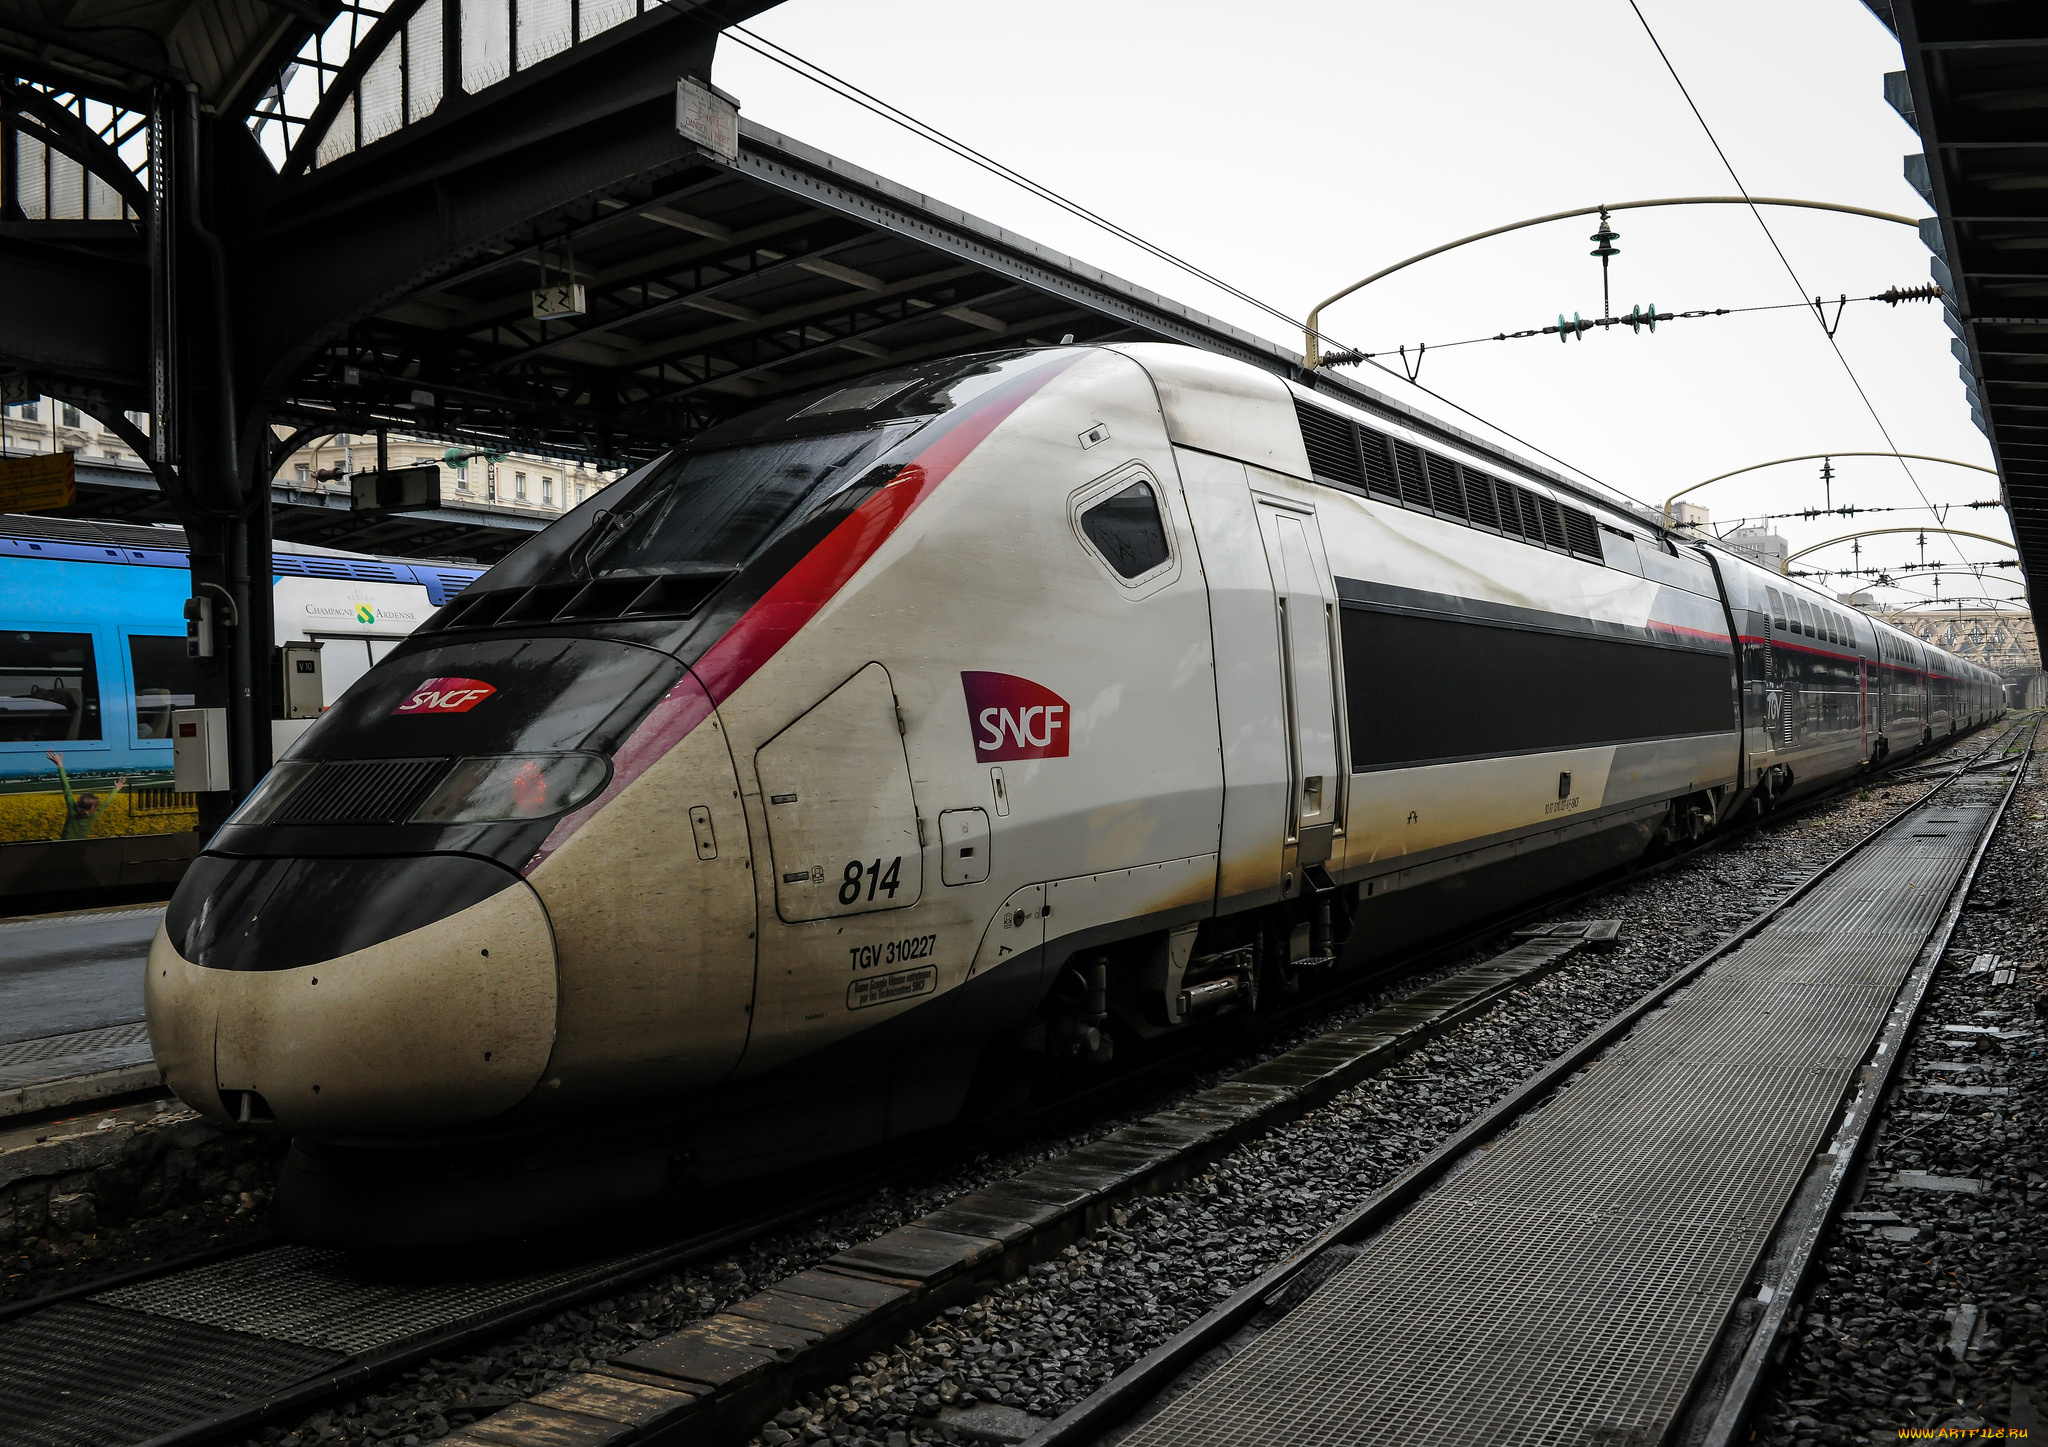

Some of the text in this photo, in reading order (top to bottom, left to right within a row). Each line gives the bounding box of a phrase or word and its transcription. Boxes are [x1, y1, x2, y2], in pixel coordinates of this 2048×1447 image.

[685, 116, 708, 134] DANGER
[376, 608, 416, 620] ARDENNE
[399, 689, 490, 710] SNCF
[978, 705, 1064, 751] SNCF
[838, 856, 902, 906] 814
[849, 933, 937, 971] TGV 310227
